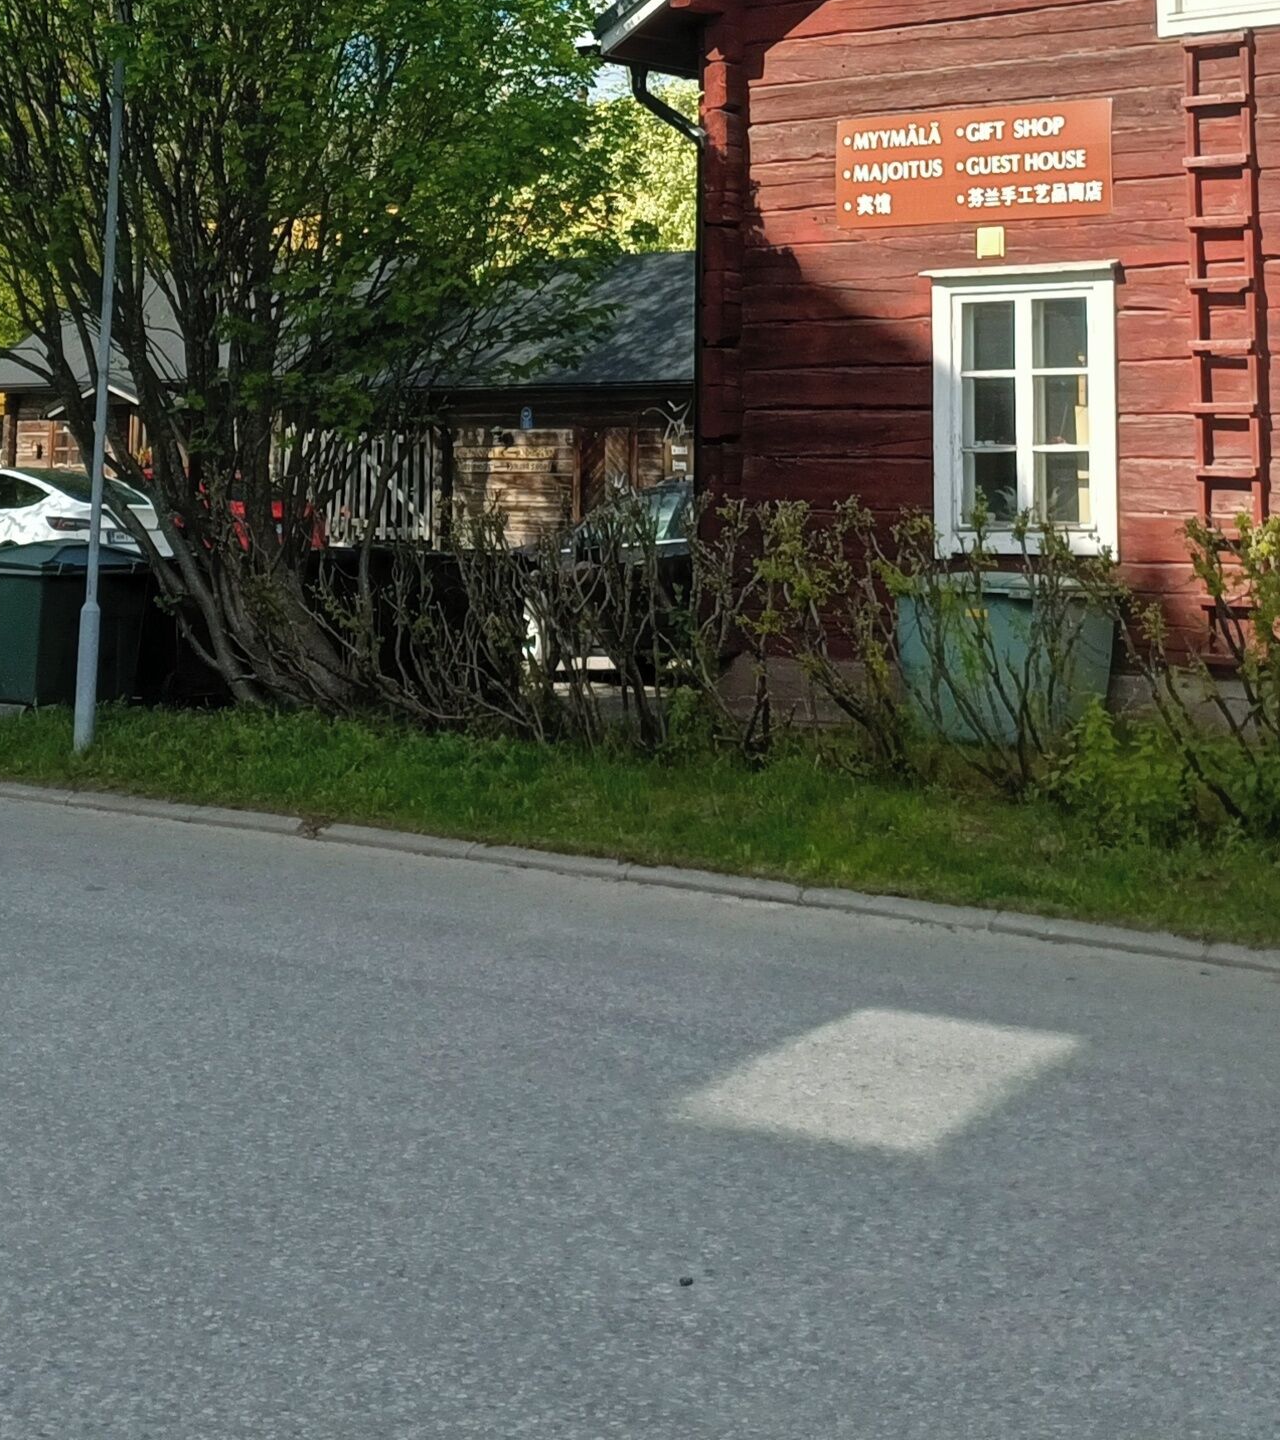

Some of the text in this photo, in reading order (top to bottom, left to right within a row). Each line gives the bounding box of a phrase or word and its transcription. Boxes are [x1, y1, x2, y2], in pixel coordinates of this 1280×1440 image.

[853, 122, 941, 150] MYYMÄLÄ
[966, 116, 1065, 142] GIFT SHOP
[853, 159, 943, 184] MAJOITUS
[966, 149, 1087, 175] GUEST HOUSE
